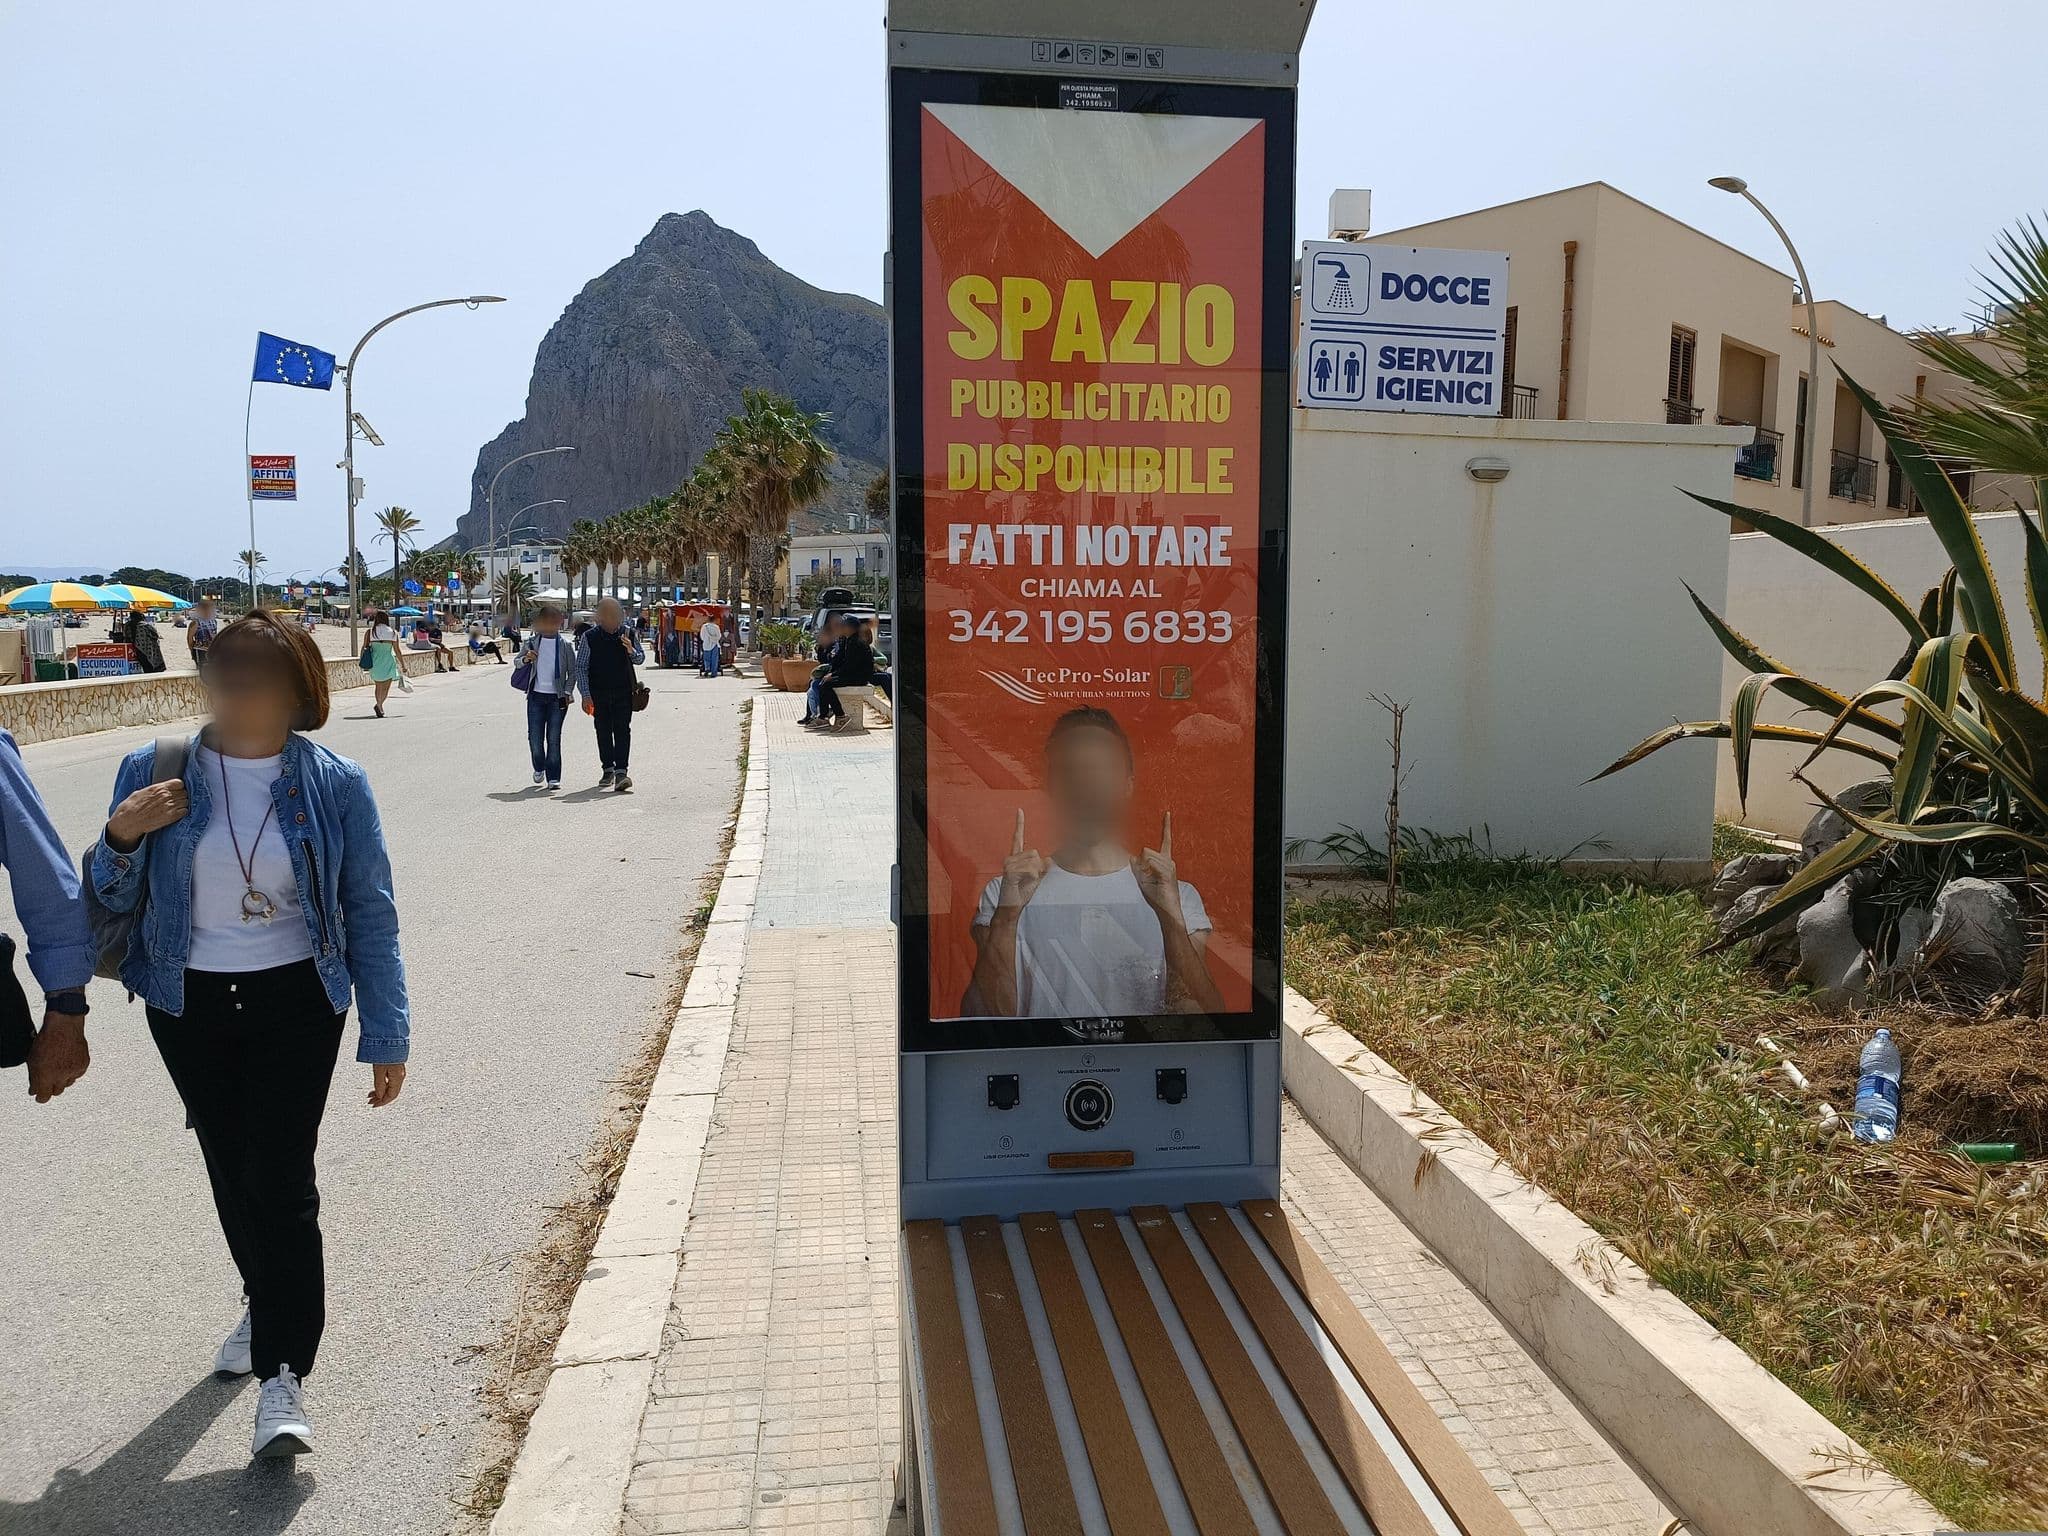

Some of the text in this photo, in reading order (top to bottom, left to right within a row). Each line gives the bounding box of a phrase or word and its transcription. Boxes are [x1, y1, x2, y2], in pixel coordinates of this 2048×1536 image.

[1381, 272, 1490, 306] DOCCE
[948, 275, 1235, 366] SPAZIO
[1378, 346, 1493, 374] SERVIZI
[951, 379, 1231, 423] PUBBLICITARIO
[1376, 377, 1492, 405] IGIENICI
[254, 470, 294, 479] AFFITTA
[948, 443, 1234, 494] DISPONIBILE
[948, 524, 1232, 567] FATTI NOTARE
[1020, 578, 1162, 598] CHIAMA AL
[948, 610, 1233, 644] 342 195 6833
[81, 660, 124, 668] ESCURSIONI
[87, 646, 116, 655] Aldo
